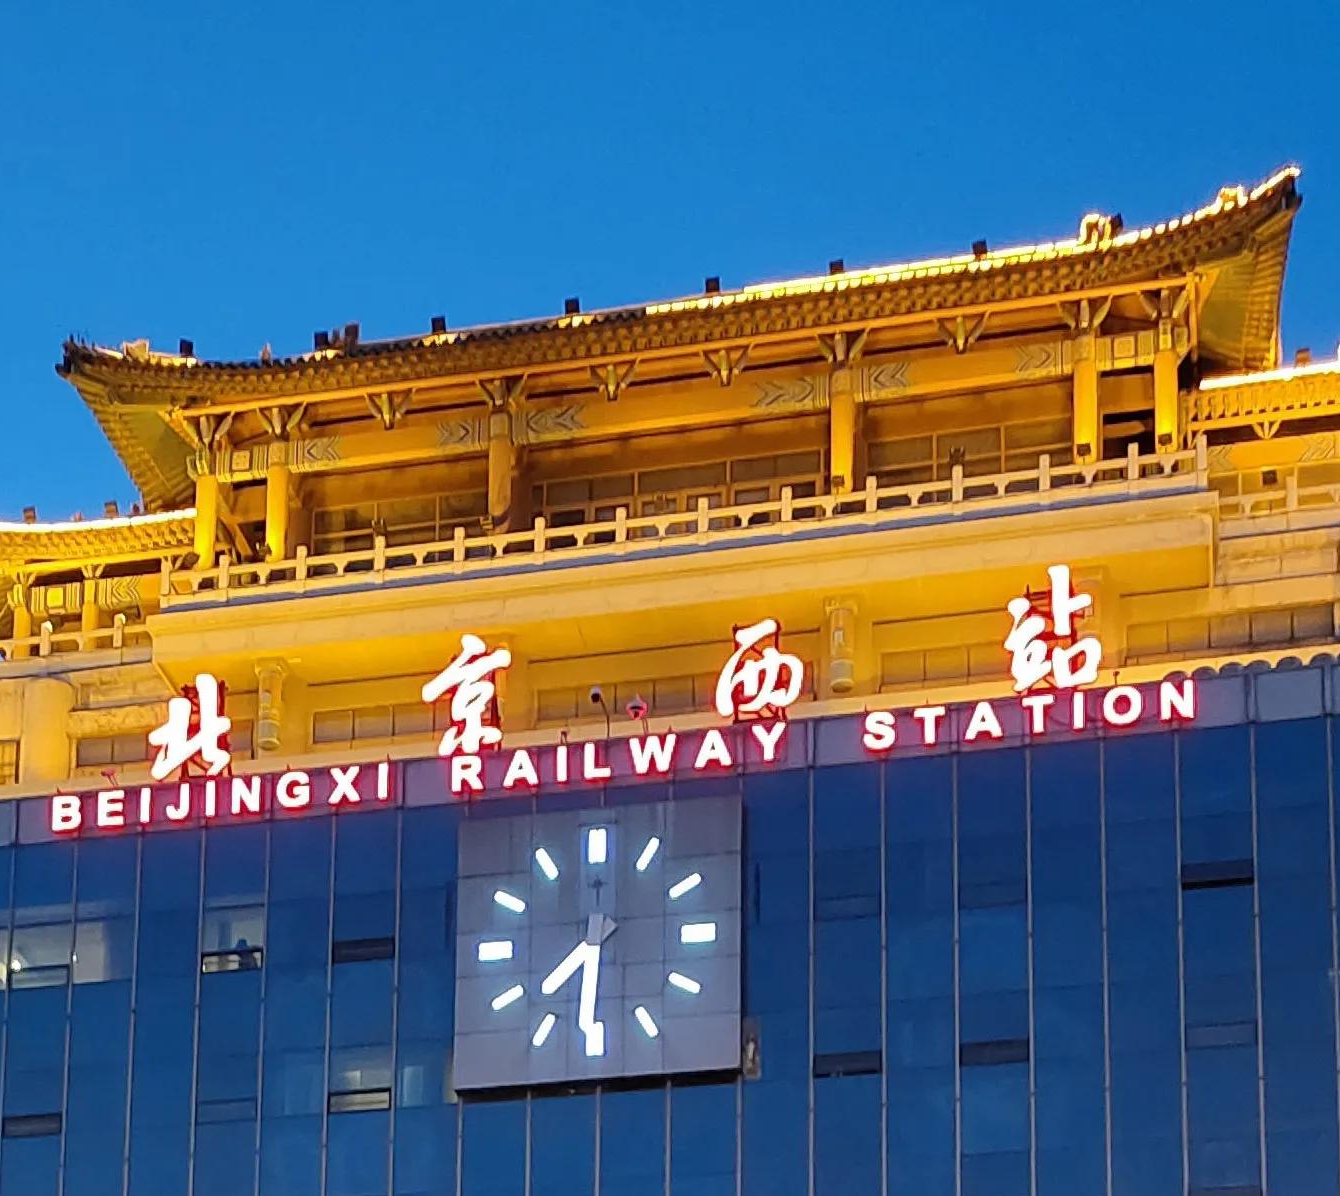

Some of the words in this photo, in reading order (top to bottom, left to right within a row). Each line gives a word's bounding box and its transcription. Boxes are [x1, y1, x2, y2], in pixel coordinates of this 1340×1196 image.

[50, 762, 390, 833] BEIJINGXI
[451, 722, 787, 793] RAILWAY
[862, 679, 1197, 751] STATION
[149, 564, 1102, 780] 北京西站
